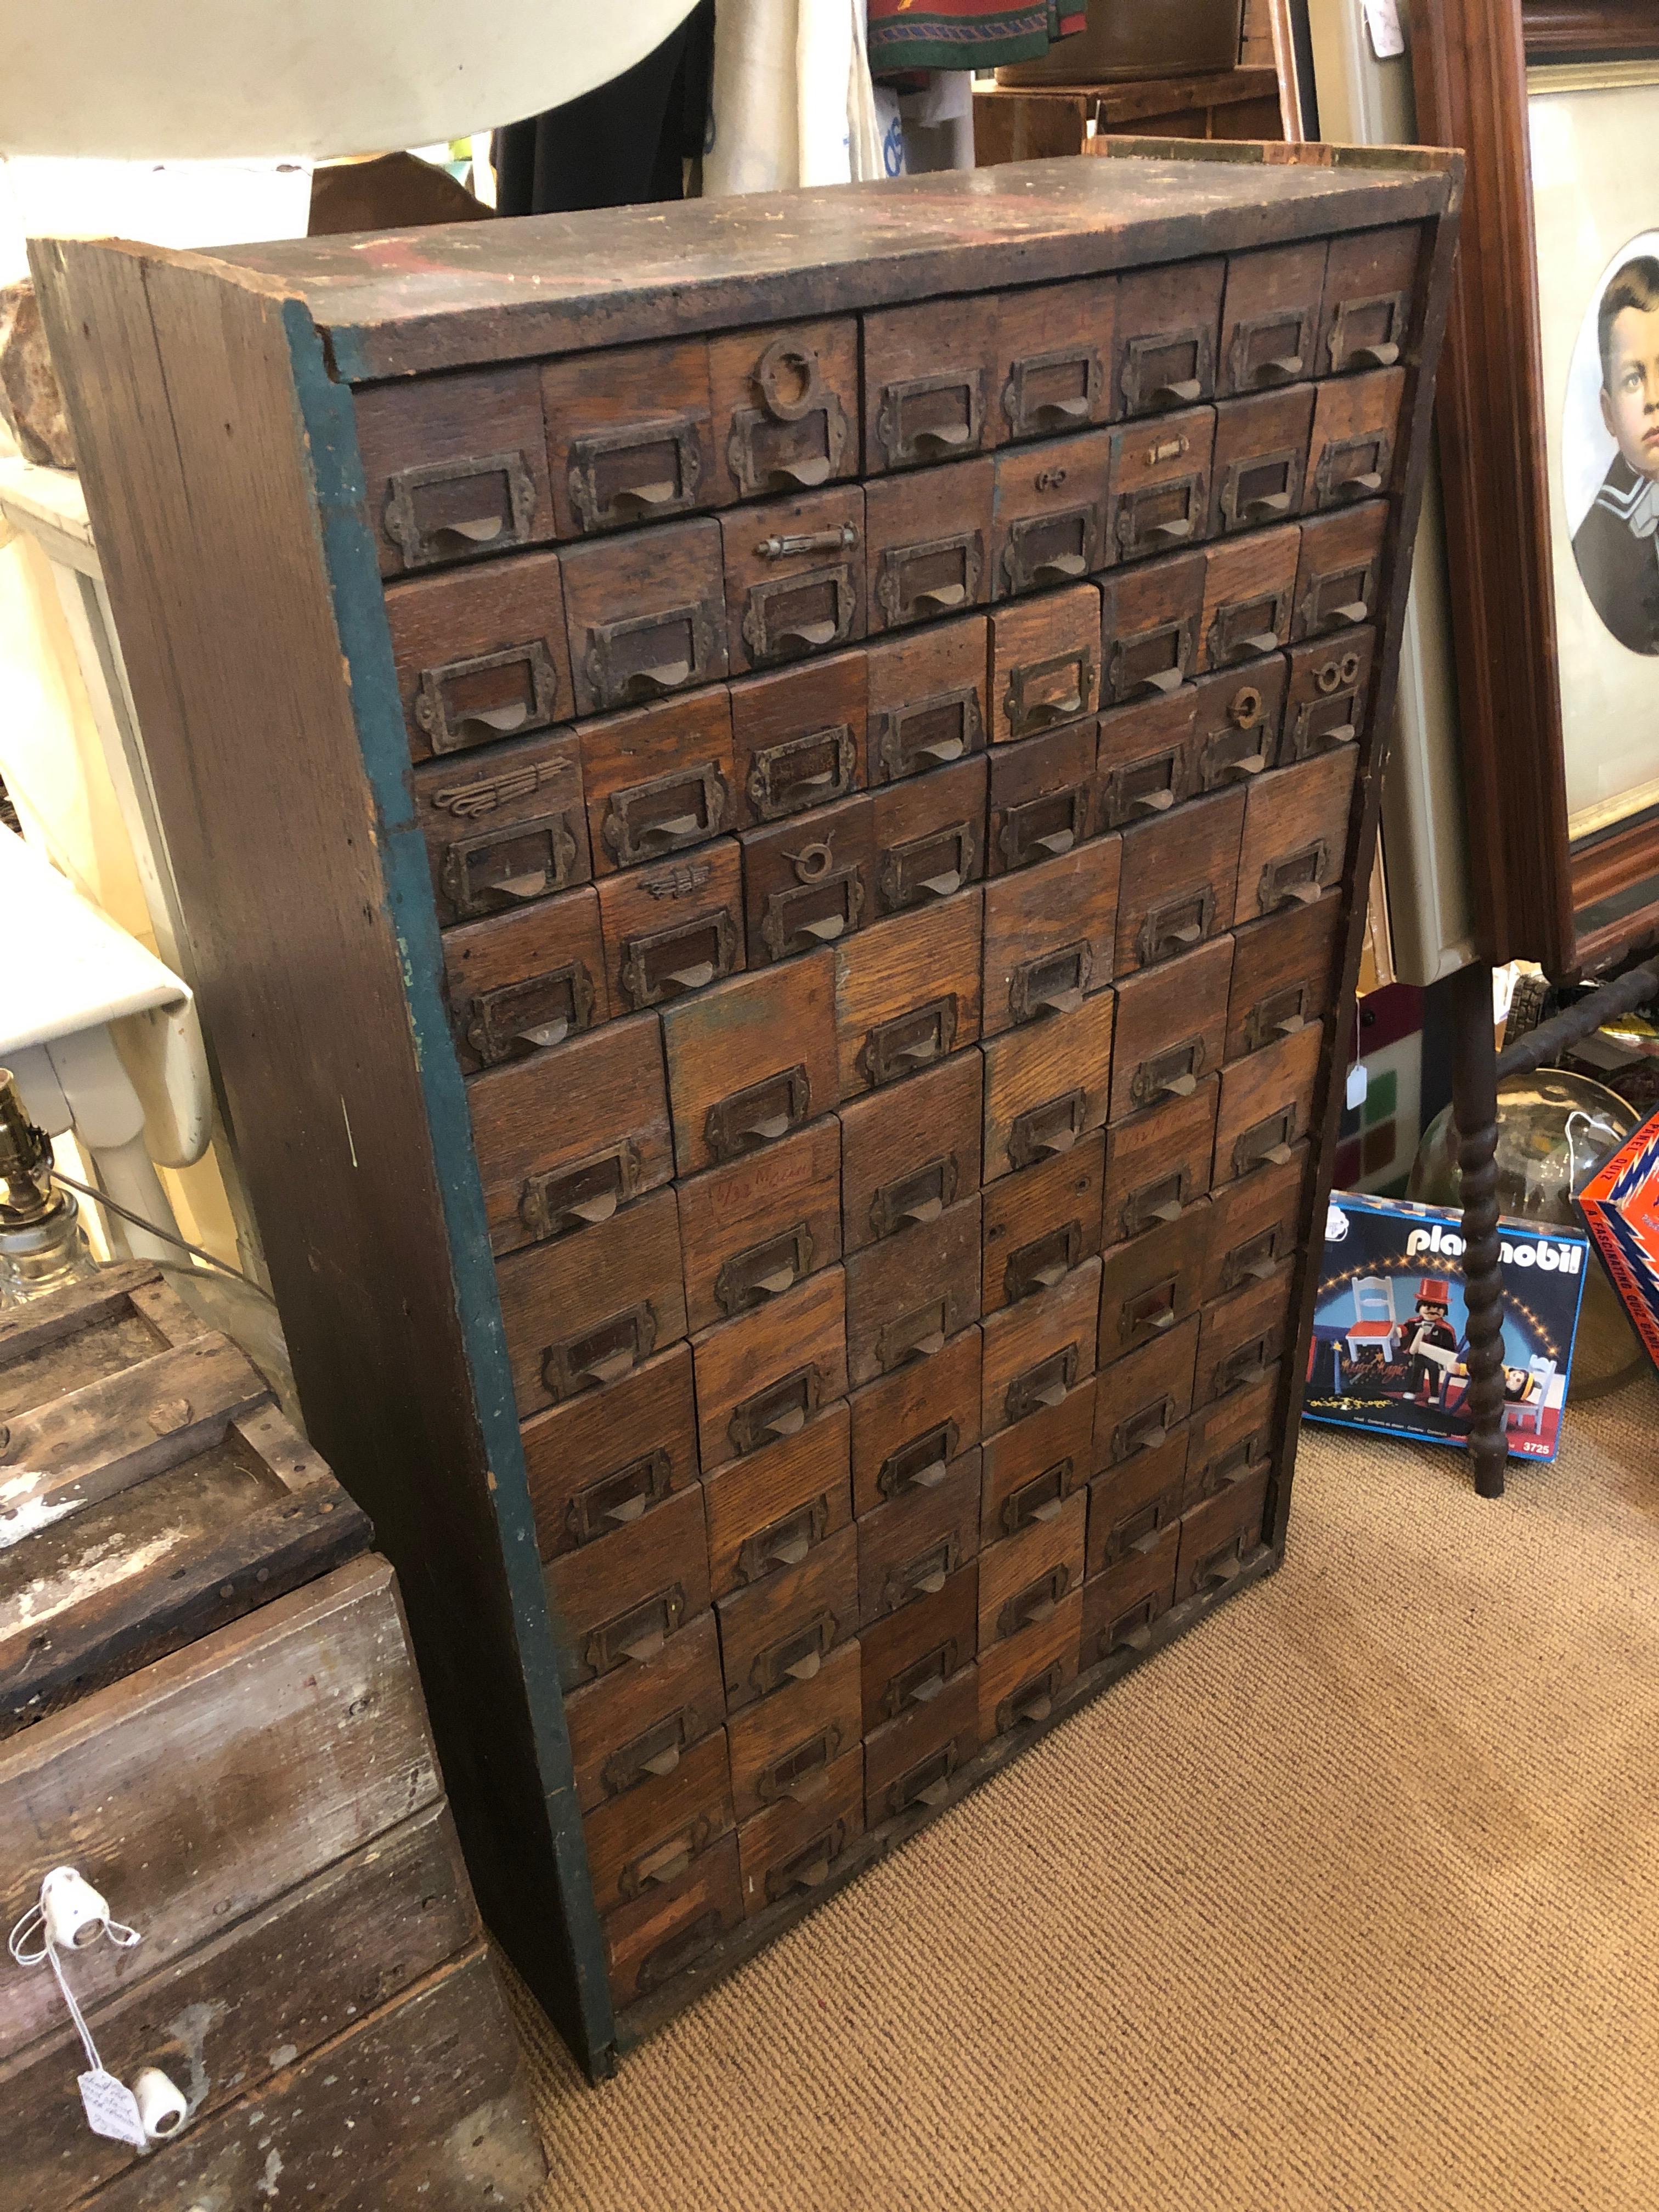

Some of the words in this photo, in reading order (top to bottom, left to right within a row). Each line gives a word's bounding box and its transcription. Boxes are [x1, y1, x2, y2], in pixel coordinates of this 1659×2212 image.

[1600, 1158, 1628, 1180] QUIZ
[1593, 1222, 1633, 1290] FASCINATING
[1626, 1294, 1647, 1318] QUIZ
[1523, 1441, 1550, 1454] 3725
